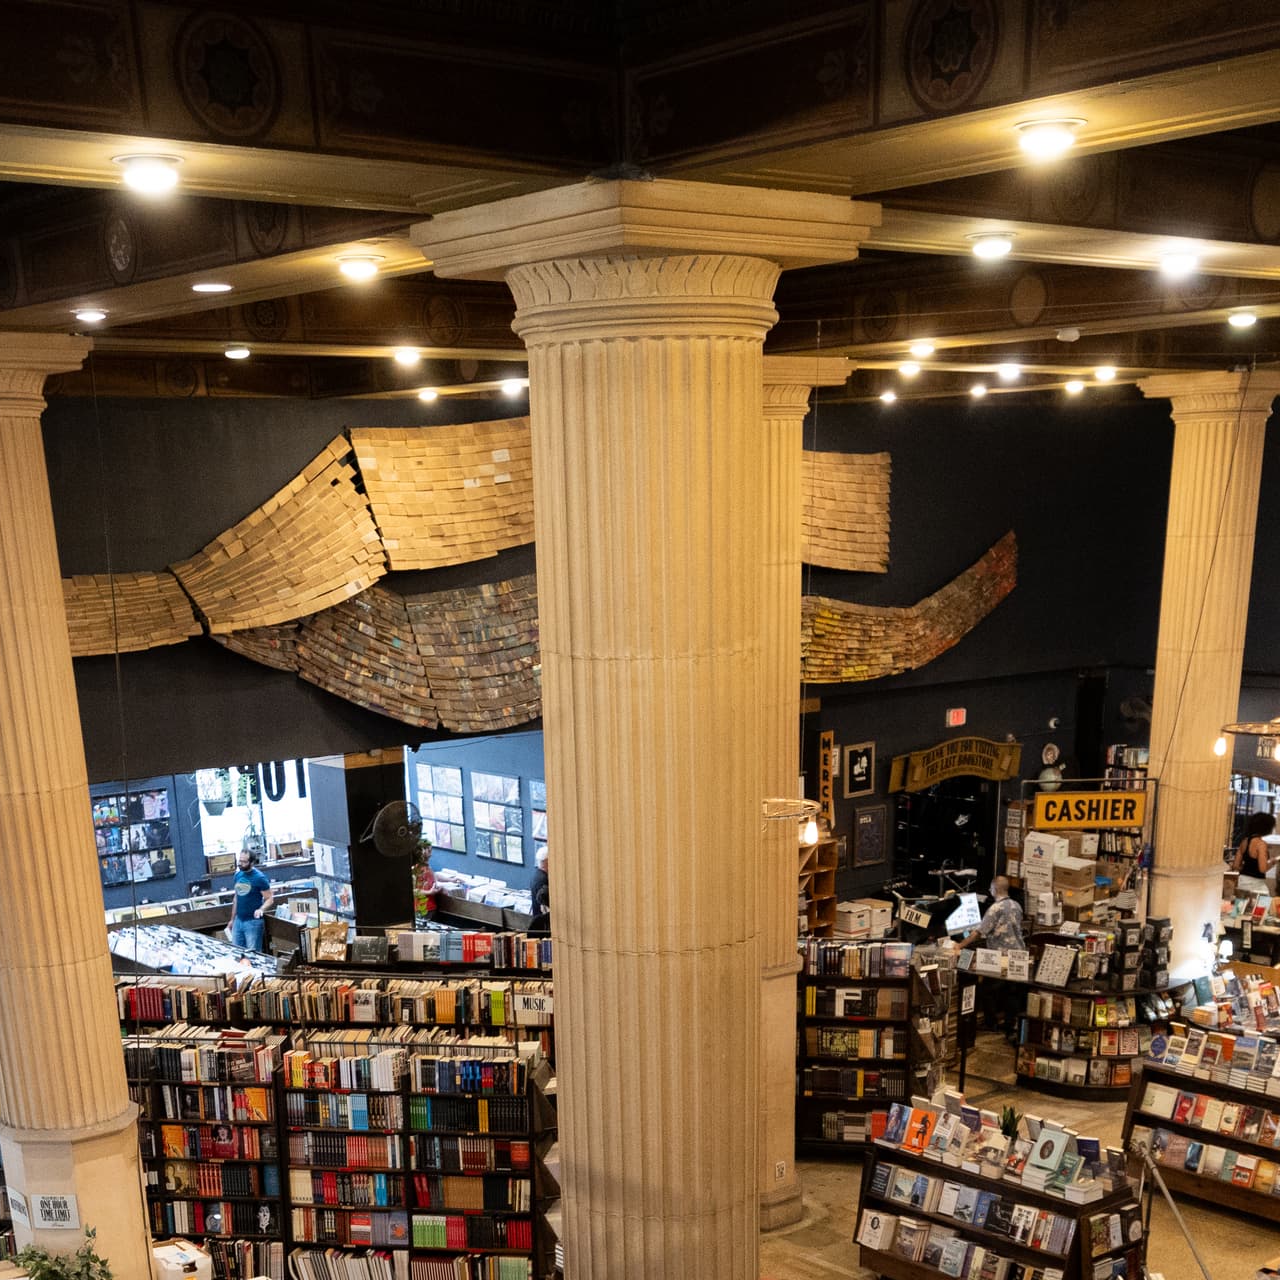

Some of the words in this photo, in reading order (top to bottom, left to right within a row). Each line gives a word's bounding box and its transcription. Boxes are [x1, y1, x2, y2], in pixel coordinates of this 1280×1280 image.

[957, 754, 993, 771] BOOKSTORE
[822, 737, 831, 814] MERCH
[1044, 798, 1137, 821] CASHIER
[297, 903, 310, 914] FILM
[905, 907, 921, 924] FILM
[522, 997, 545, 1011] MUSIC
[40, 1200, 52, 1209] ONE
[52, 1200, 68, 1209] HOUR
[40, 1209, 54, 1219] TIME
[55, 1209, 71, 1219] LIMIT
